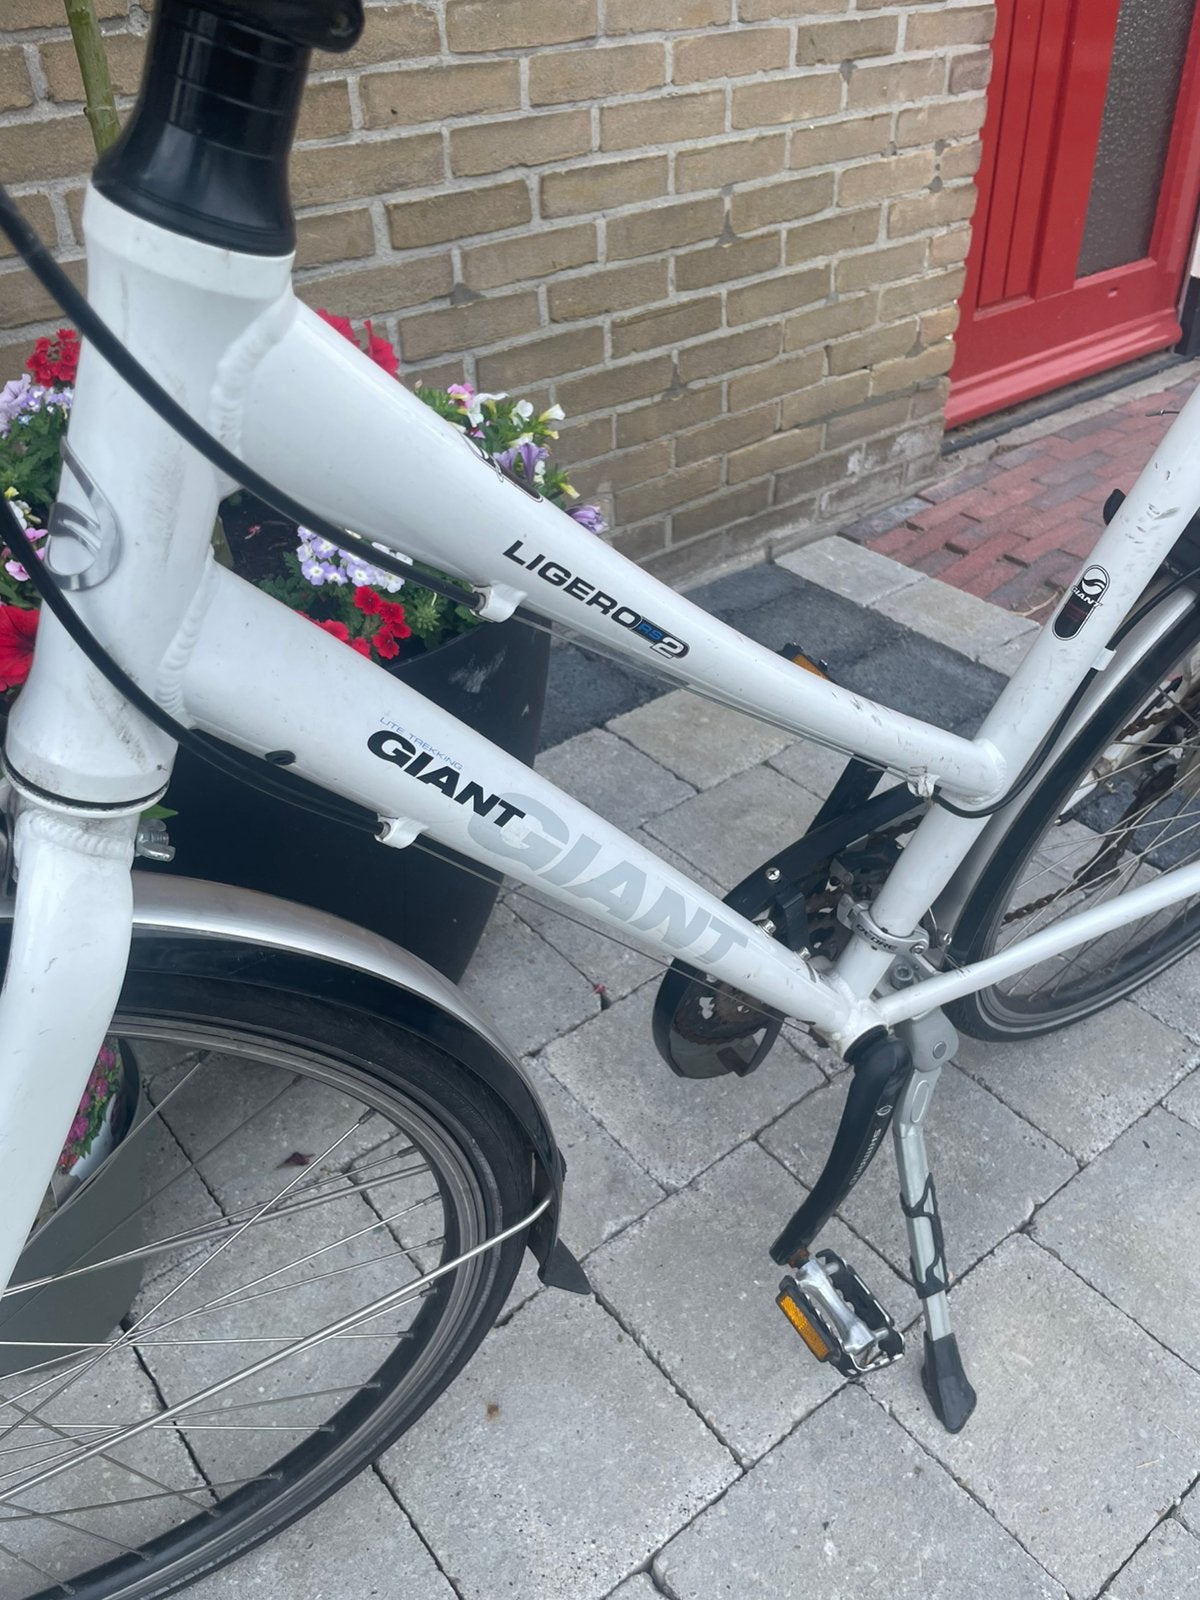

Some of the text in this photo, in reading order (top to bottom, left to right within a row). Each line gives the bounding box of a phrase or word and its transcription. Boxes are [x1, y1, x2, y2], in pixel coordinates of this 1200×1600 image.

[503, 540, 642, 628] LIGERO
[1071, 585, 1103, 607] GIANT
[367, 730, 526, 828] GIANT
[379, 717, 463, 771] LITE TREKKING
[467, 792, 749, 964] GIANT
[856, 924, 899, 949] DEORE
